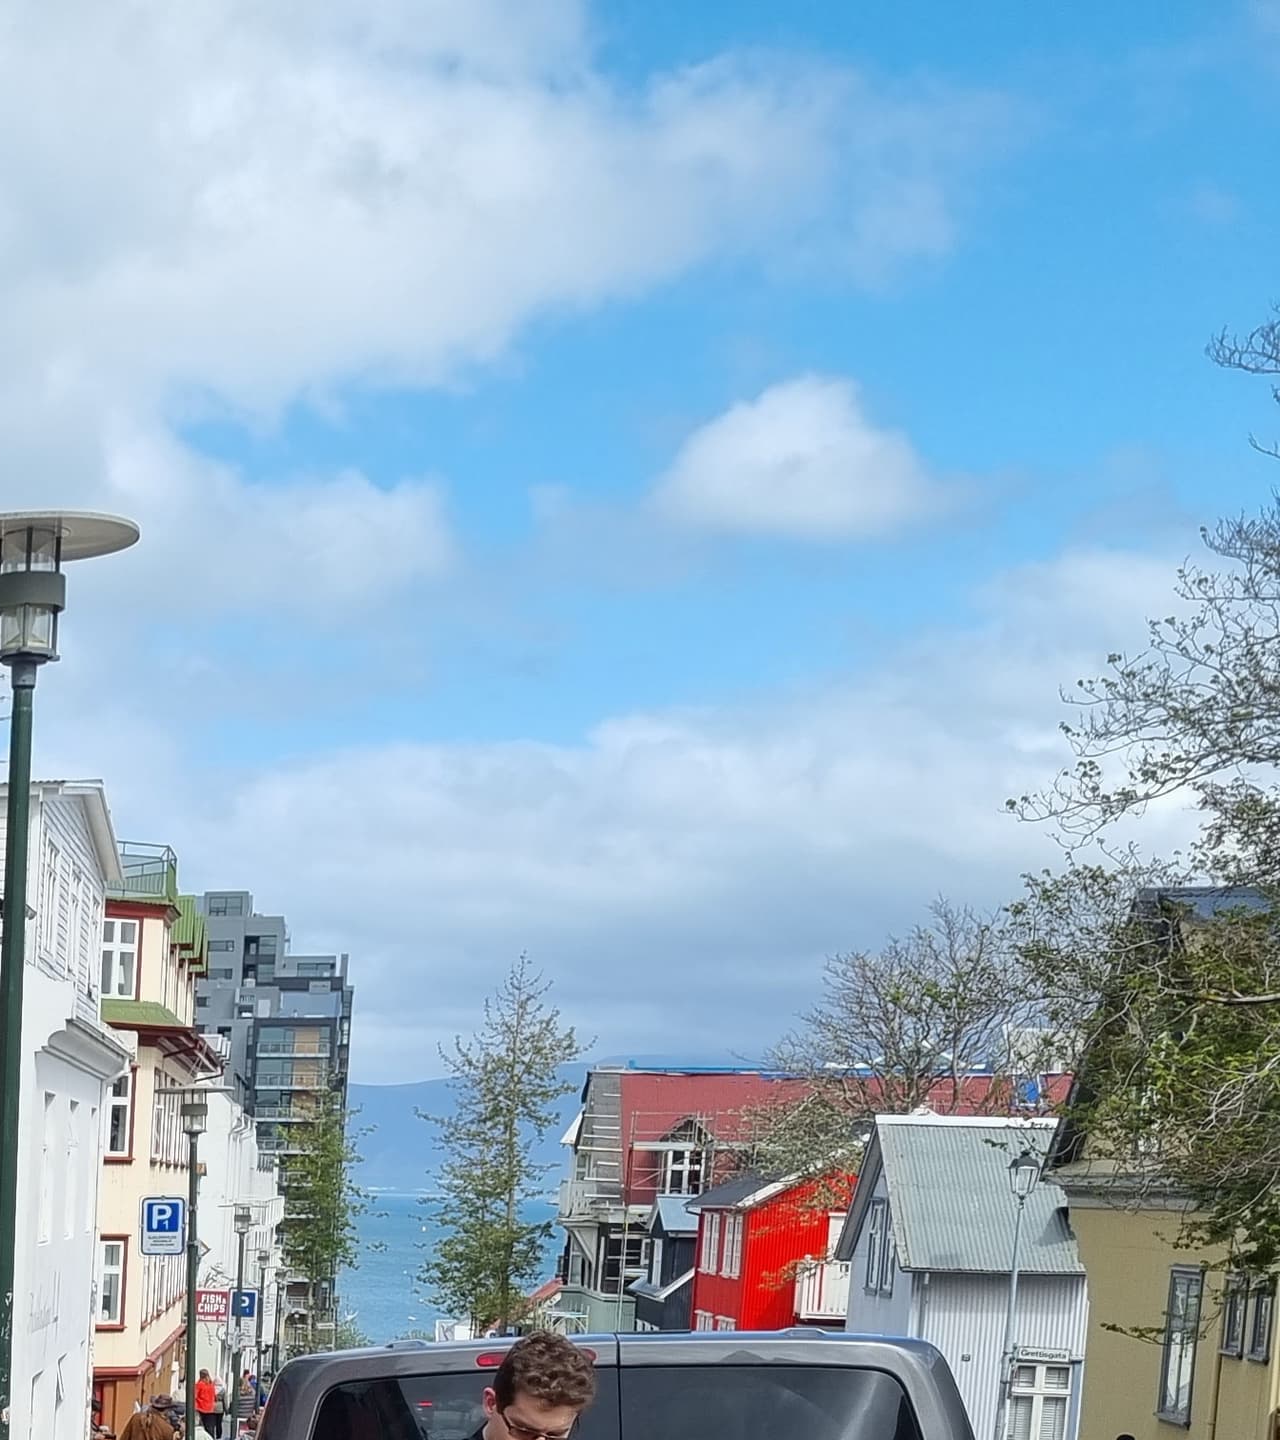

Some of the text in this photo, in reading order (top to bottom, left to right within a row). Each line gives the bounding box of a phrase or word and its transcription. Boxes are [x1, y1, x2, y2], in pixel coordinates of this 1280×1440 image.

[152, 1205, 173, 1230] P
[163, 1220, 170, 1230] 1
[201, 1294, 222, 1304] FISH
[197, 1304, 225, 1313] CHIPS
[1021, 1349, 1067, 1360] Grettisgata
